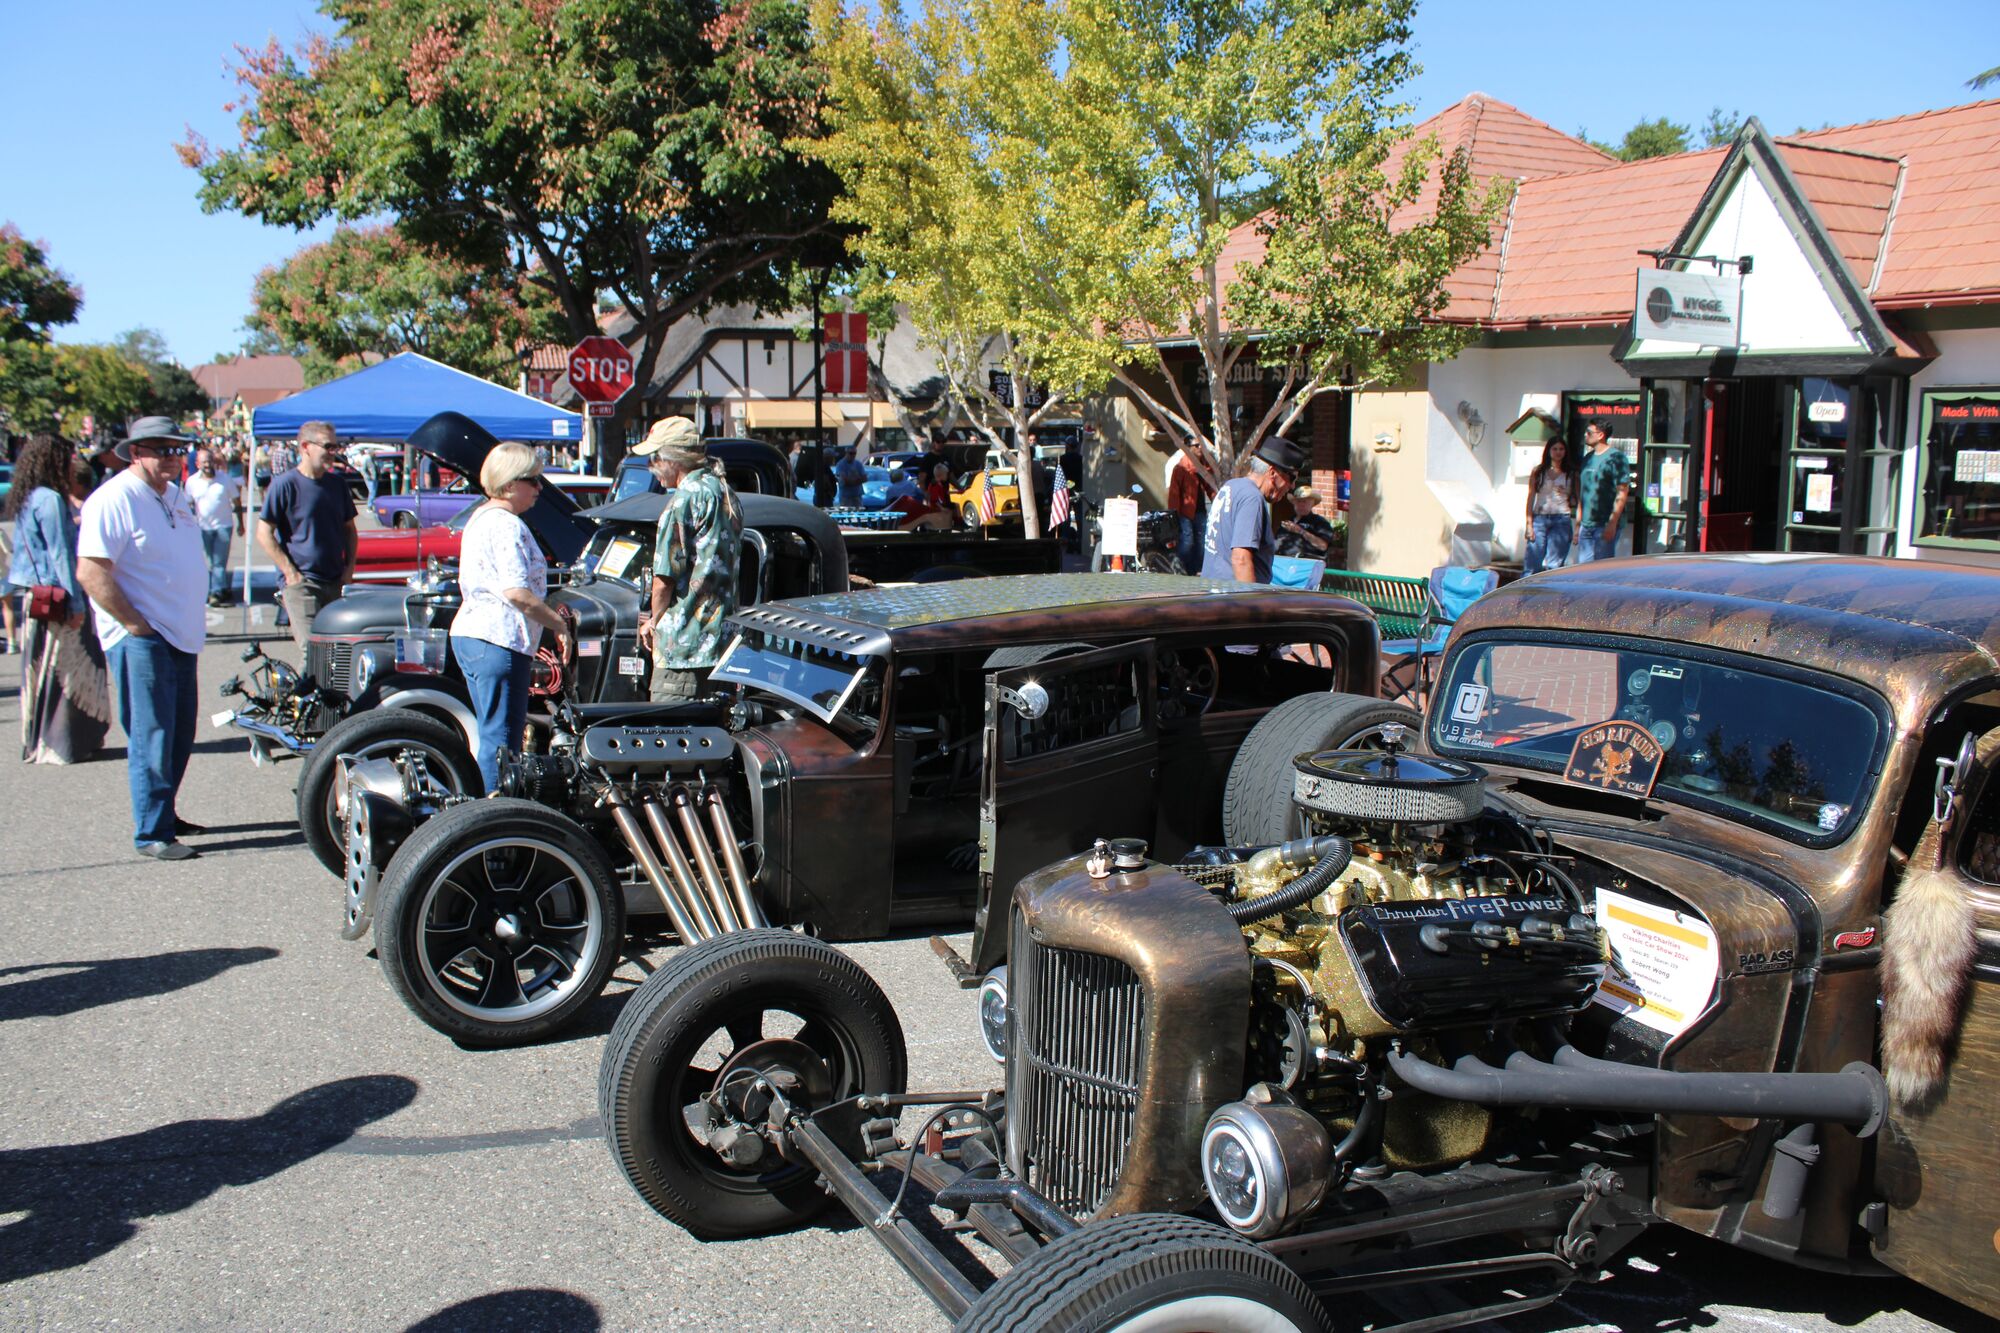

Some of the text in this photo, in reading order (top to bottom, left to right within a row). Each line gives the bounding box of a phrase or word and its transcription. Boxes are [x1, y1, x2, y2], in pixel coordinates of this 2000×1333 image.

[1683, 297, 1722, 312] HYGGE
[572, 357, 630, 382] STOP
[590, 405, 612, 415] 4-WAY
[1578, 405, 1595, 415] Made
[1597, 405, 1612, 415] With
[1614, 405, 1633, 415] Fresh
[1814, 406, 1838, 417] Open
[1941, 405, 1999, 417] Made With
[1440, 723, 1483, 739] UBER
[1606, 727, 1633, 743] RAT
[1459, 736, 1472, 744] CITY
[1471, 739, 1495, 749] CLASSICS
[1373, 898, 1566, 922] Chrysler FirePower
[1622, 932, 1689, 962] Classic Car Show 2024
[1632, 928, 1681, 950] Viking Charities
[1739, 948, 1795, 968] BAD ASS
[1631, 958, 1671, 979] Robert Wong
[818, 969, 872, 1010] DELUXE
